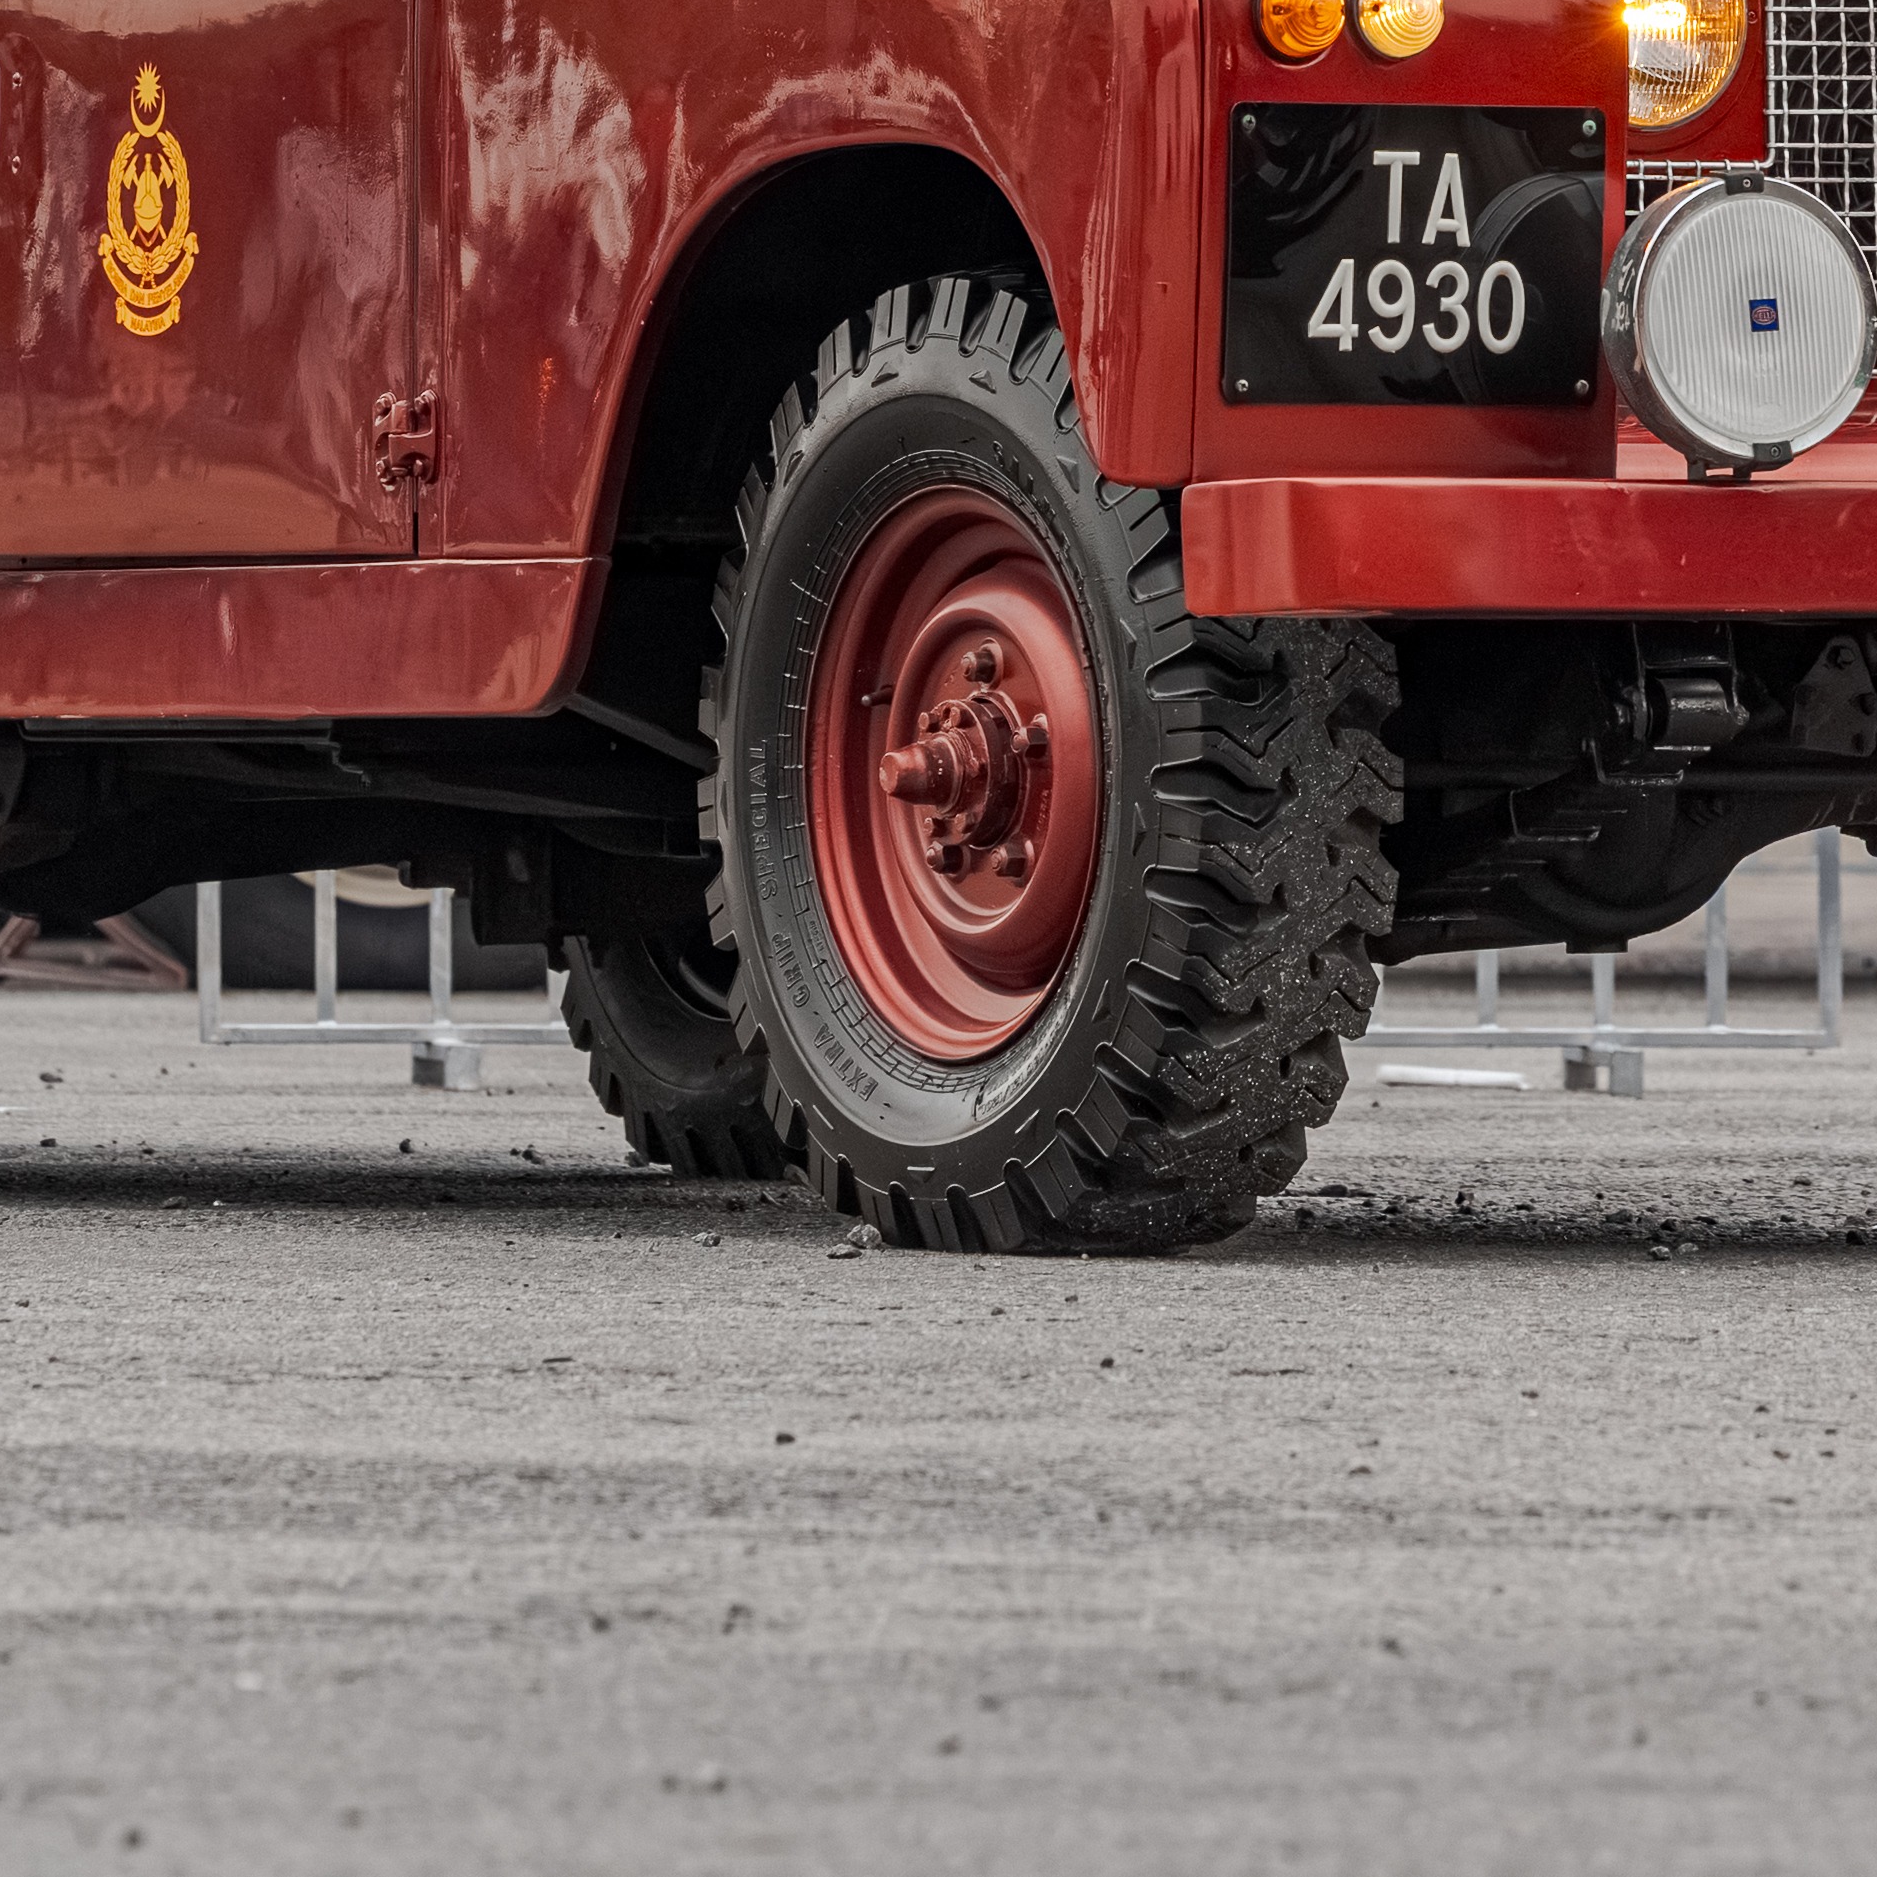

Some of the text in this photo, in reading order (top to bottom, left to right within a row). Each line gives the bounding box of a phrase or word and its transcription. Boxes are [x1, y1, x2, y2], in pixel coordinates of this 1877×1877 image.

[1373, 150, 1471, 248] TA
[1308, 258, 1525, 355] 4930
[748, 739, 879, 1102] EXTRA GRIP SPECIAL
